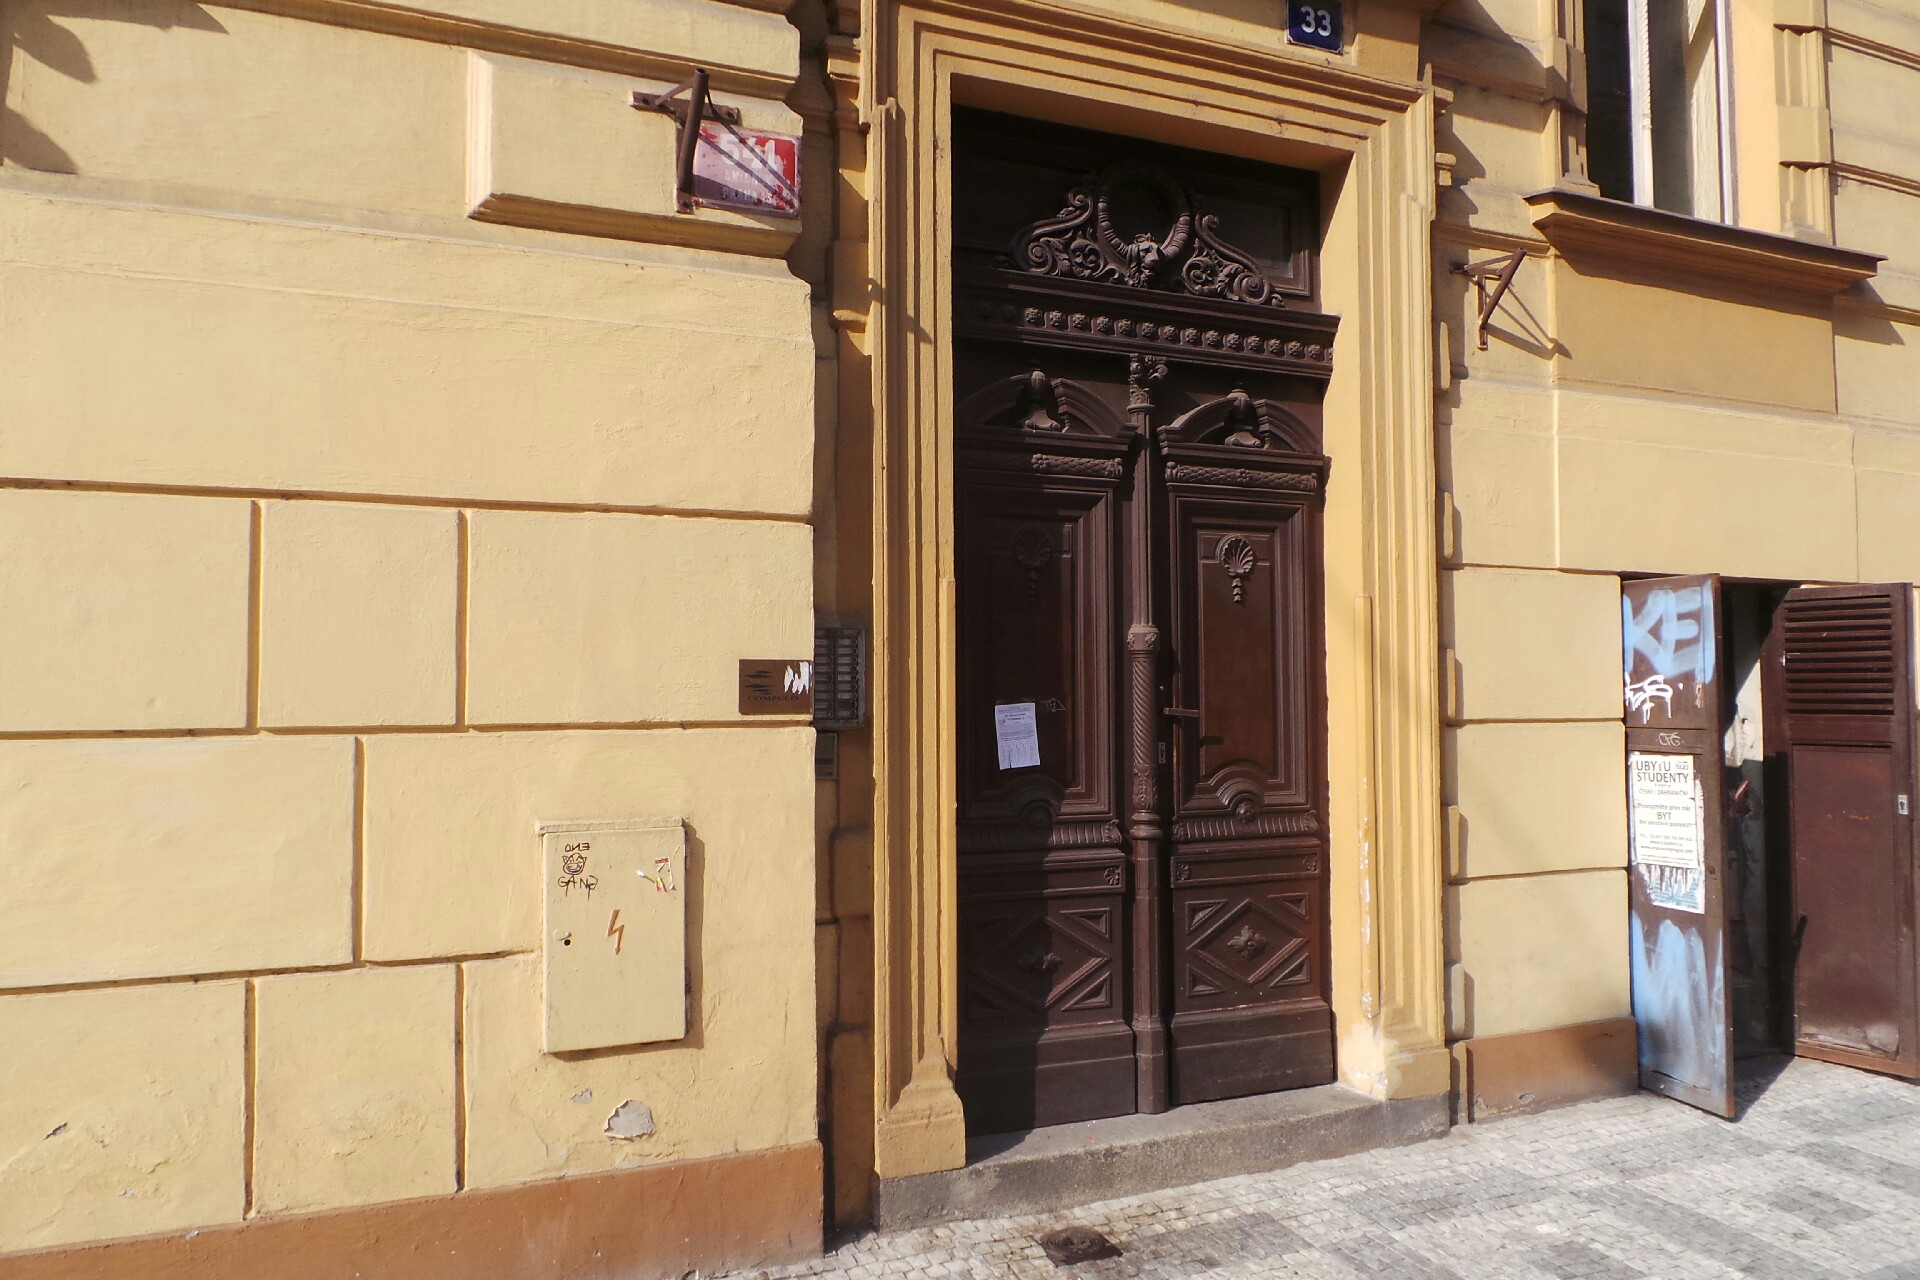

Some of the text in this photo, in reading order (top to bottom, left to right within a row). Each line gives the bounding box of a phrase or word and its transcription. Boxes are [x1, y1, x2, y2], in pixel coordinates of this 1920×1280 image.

[1301, 5, 1332, 37] 33
[1637, 771, 1689, 783] STUDENTY
[1657, 811, 1672, 820] BYT
